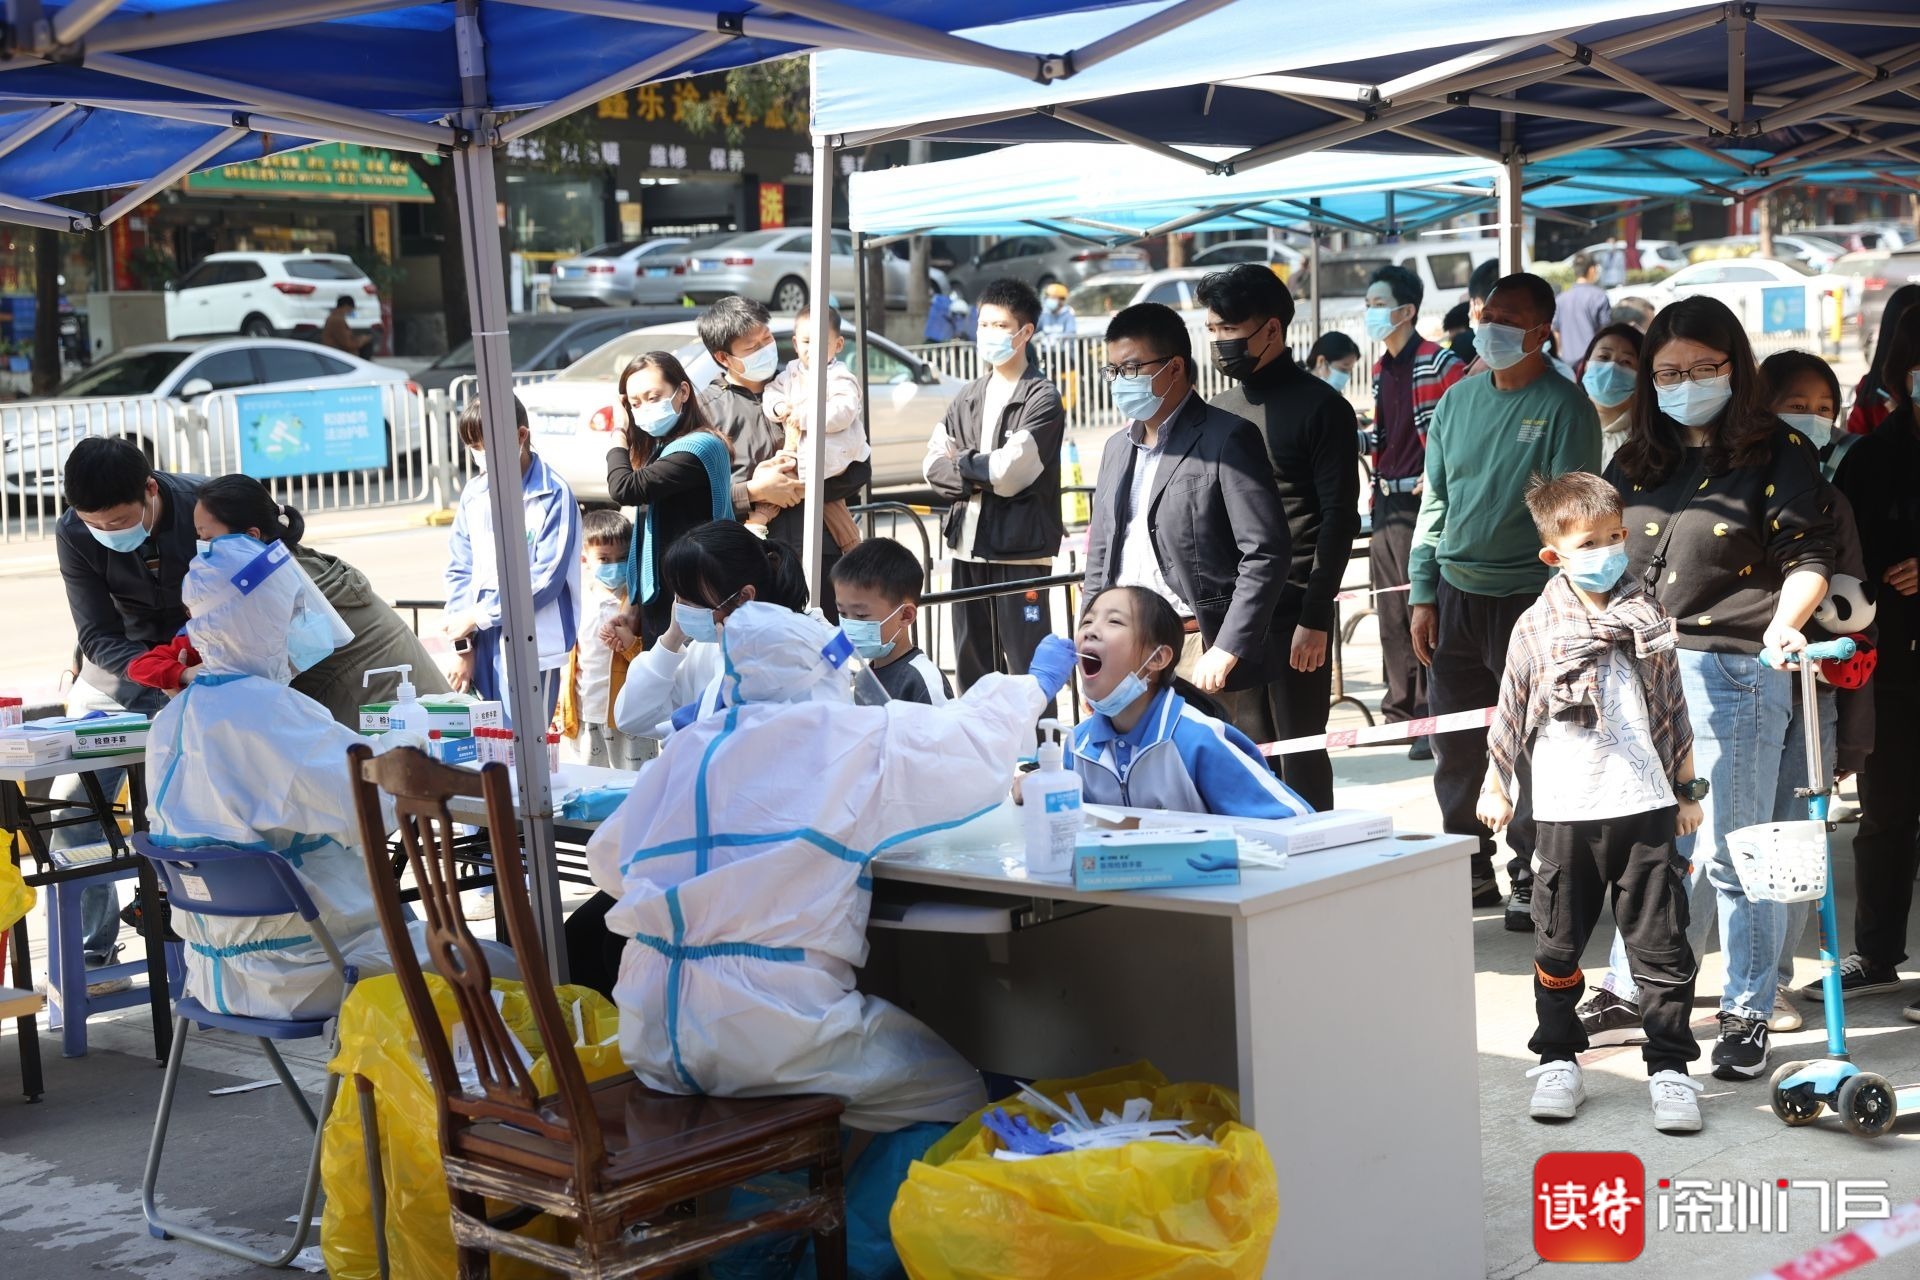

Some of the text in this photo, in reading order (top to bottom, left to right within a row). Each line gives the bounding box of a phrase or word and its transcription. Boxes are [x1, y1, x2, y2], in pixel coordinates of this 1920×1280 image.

[649, 143, 687, 169] 维修
[709, 147, 745, 172] 保养
[760, 186, 784, 224] 洗
[94, 735, 127, 746] 检查手套
